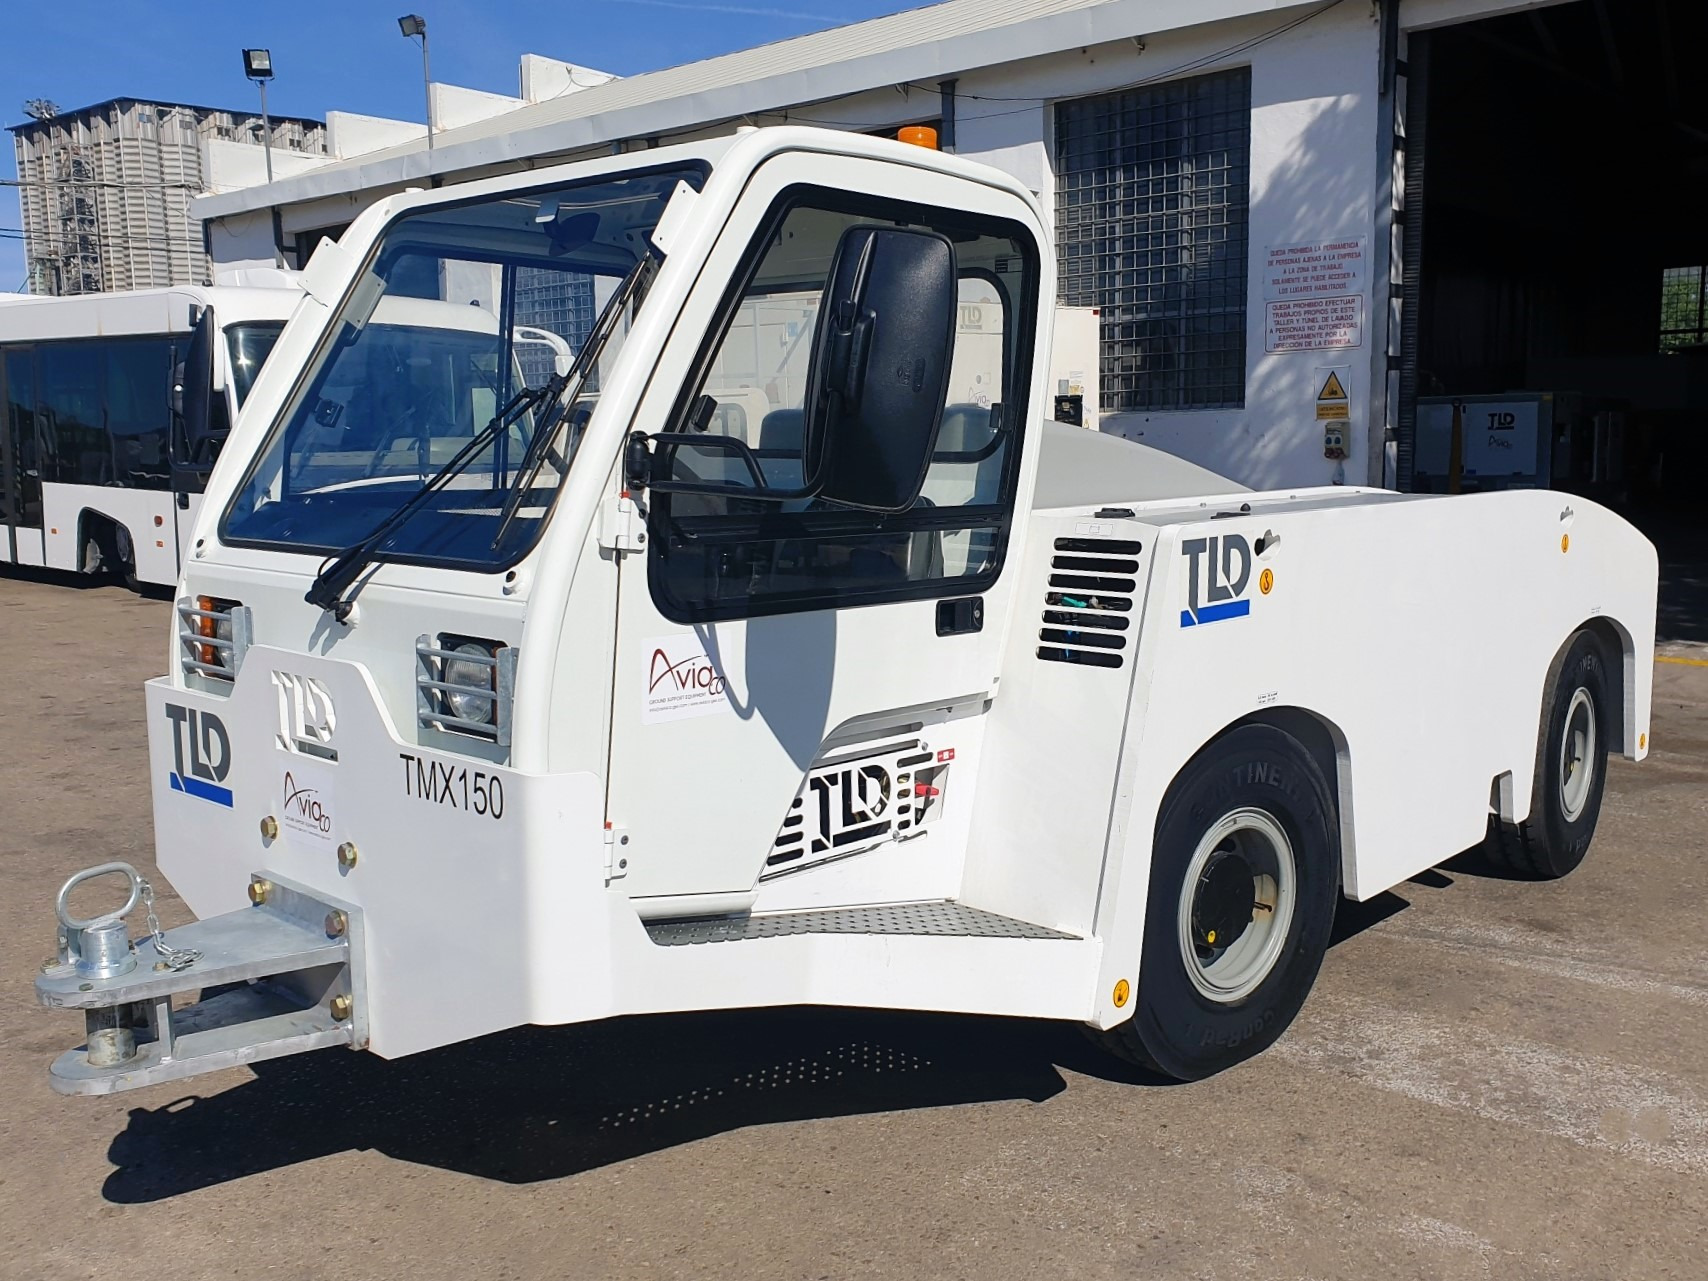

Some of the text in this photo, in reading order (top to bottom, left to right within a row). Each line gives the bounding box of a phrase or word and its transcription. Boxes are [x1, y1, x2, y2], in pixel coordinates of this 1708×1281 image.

[1275, 258, 1301, 266] PERSONAS
[1320, 263, 1343, 271] TRABAJO
[1290, 285, 1312, 293] LUGARES
[1293, 301, 1323, 309] PROHIBIDO
[1325, 298, 1355, 306] EFECTUAR
[960, 306, 982, 325] TLD
[1272, 310, 1302, 319] TRABAJOS
[1304, 308, 1328, 316] PROPIOS
[1274, 318, 1294, 326] TALLER
[1331, 314, 1353, 322] LAVADO
[1318, 322, 1358, 330] AUTORIZADAS
[1278, 333, 1322, 341] EXPRESAMENTE
[1488, 413, 1515, 428] TLD
[1182, 534, 1252, 622] TLD
[271, 670, 337, 751] TLD
[165, 702, 231, 792] TLD
[400, 753, 504, 819] TMX150
[810, 765, 891, 848] TLD
